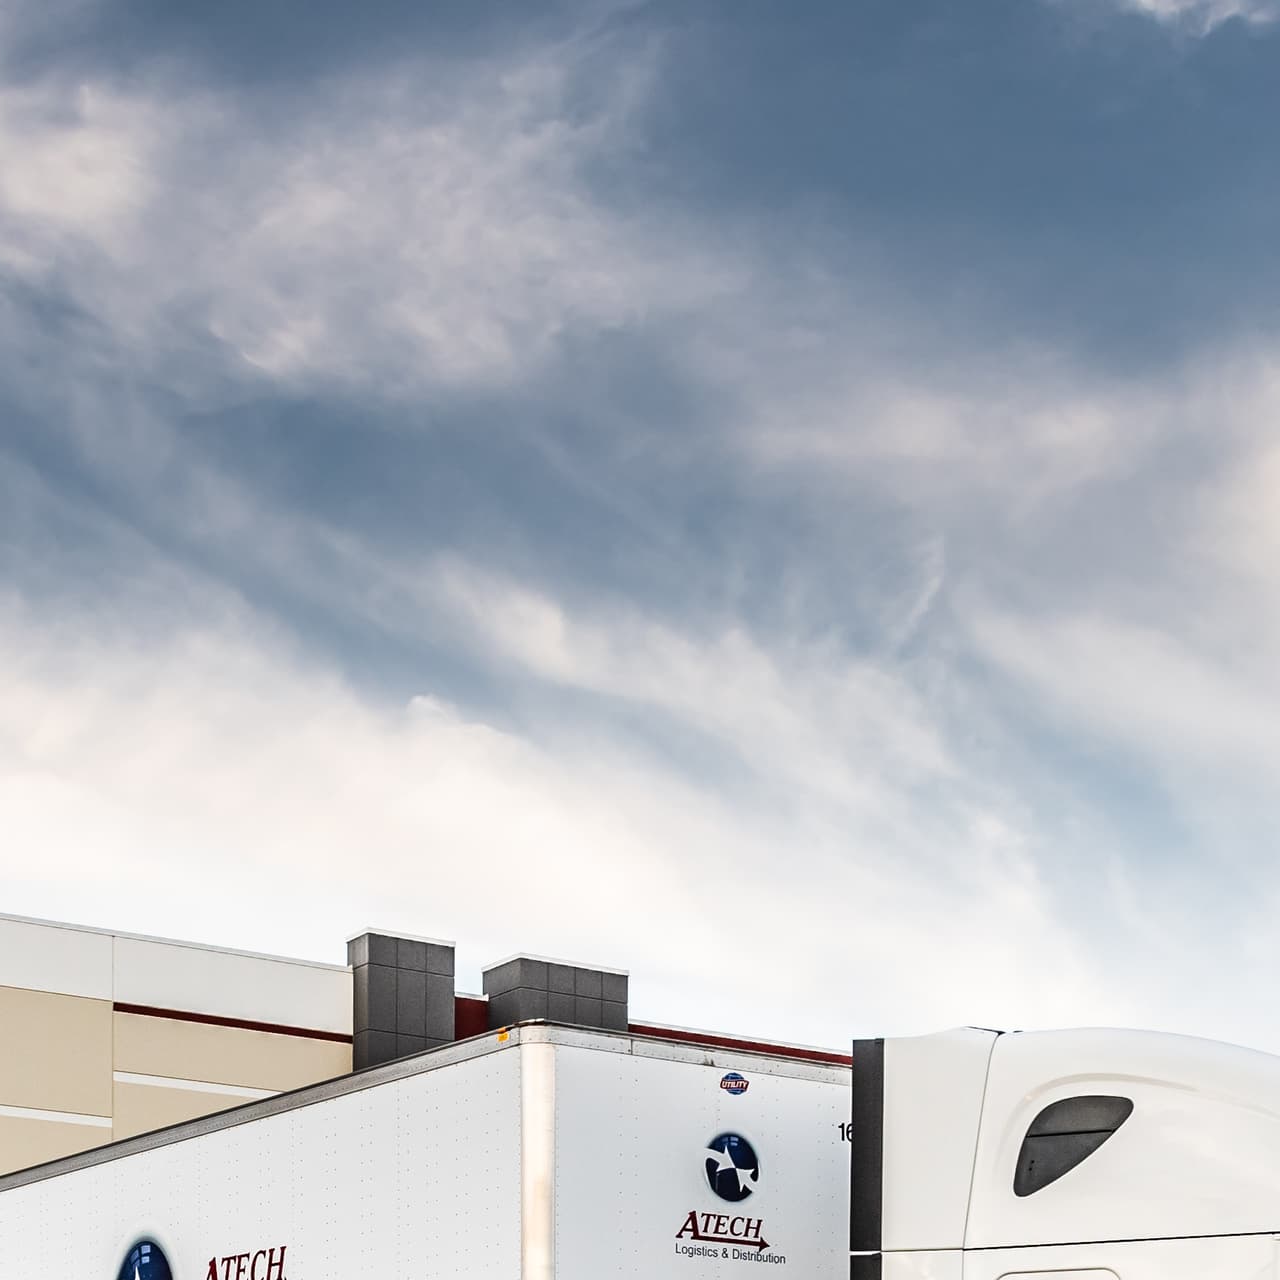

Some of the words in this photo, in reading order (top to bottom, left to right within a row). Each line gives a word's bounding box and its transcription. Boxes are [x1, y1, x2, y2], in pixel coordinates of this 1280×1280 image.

[721, 1080, 748, 1089] UTILITY
[676, 1210, 763, 1239] ATECH
[675, 1243, 719, 1258] Logistics
[721, 1248, 729, 1259] &
[732, 1249, 787, 1264] Distribution
